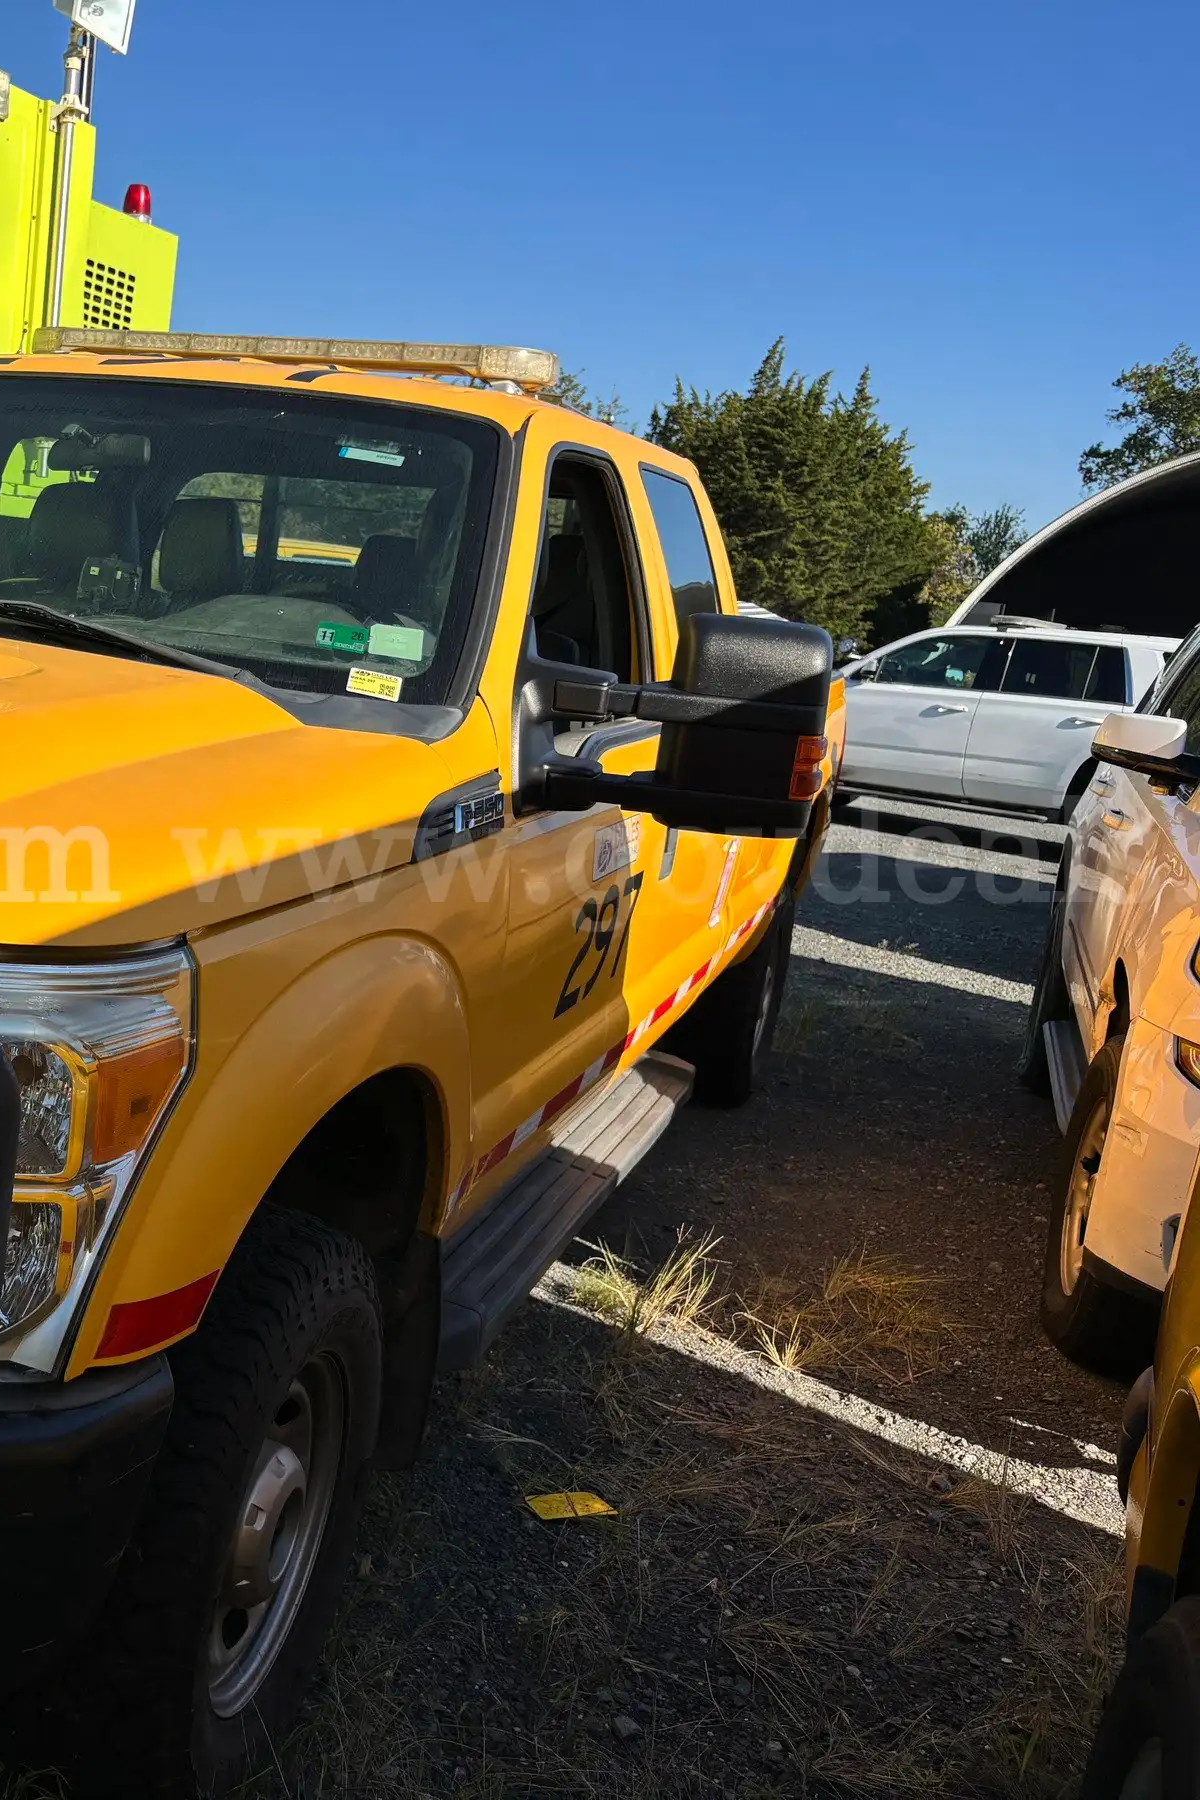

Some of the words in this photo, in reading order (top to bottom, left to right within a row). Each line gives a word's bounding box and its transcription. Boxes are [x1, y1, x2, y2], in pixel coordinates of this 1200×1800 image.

[322, 630, 335, 642] 11
[350, 631, 365, 641] 26
[553, 870, 645, 1020] 297
